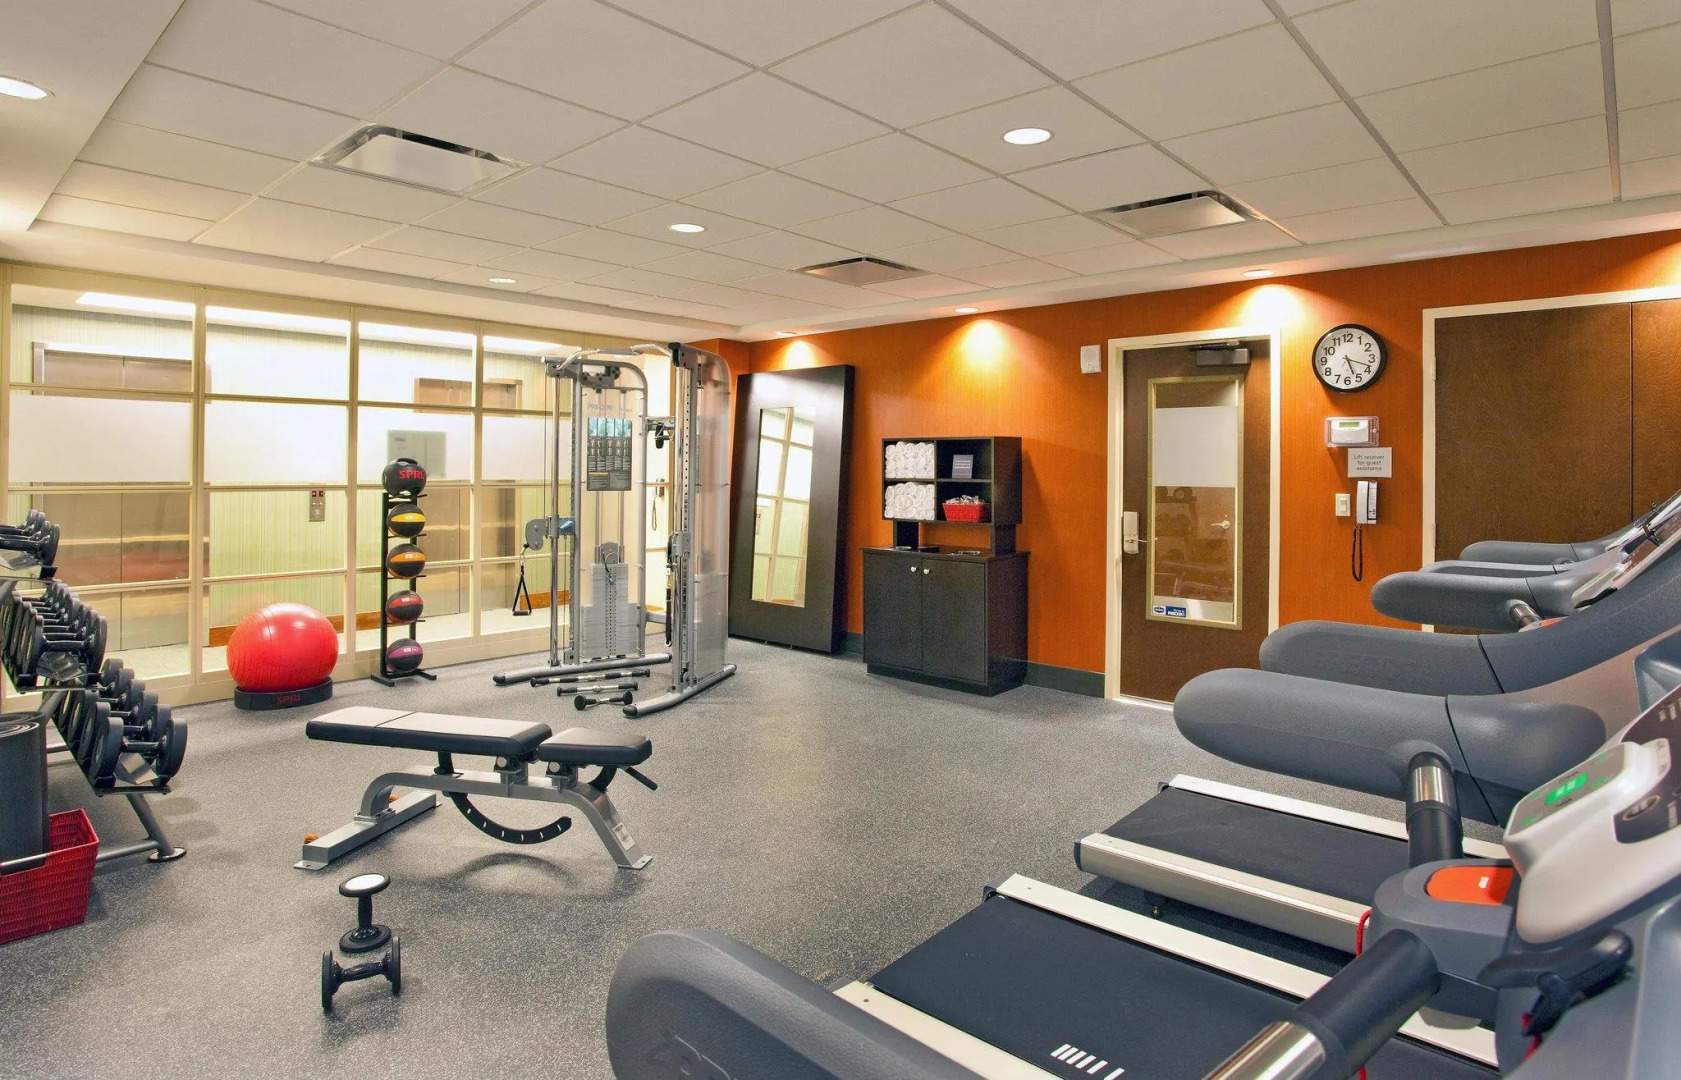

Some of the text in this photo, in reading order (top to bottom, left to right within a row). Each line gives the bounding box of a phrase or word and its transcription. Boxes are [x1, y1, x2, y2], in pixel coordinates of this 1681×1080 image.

[1331, 337, 1341, 346] 11
[1342, 333, 1354, 343] 12
[1357, 336, 1362, 345] 1
[1323, 347, 1335, 356] 10
[1364, 343, 1372, 352] 2
[1320, 357, 1327, 365] 9
[1368, 354, 1376, 363] 3
[1324, 368, 1332, 376] 8
[1364, 365, 1372, 374] 4
[1334, 375, 1341, 384] 7
[1344, 377, 1351, 385] 6
[1355, 374, 1363, 382] 5
[277, 695, 300, 704] SPRI
